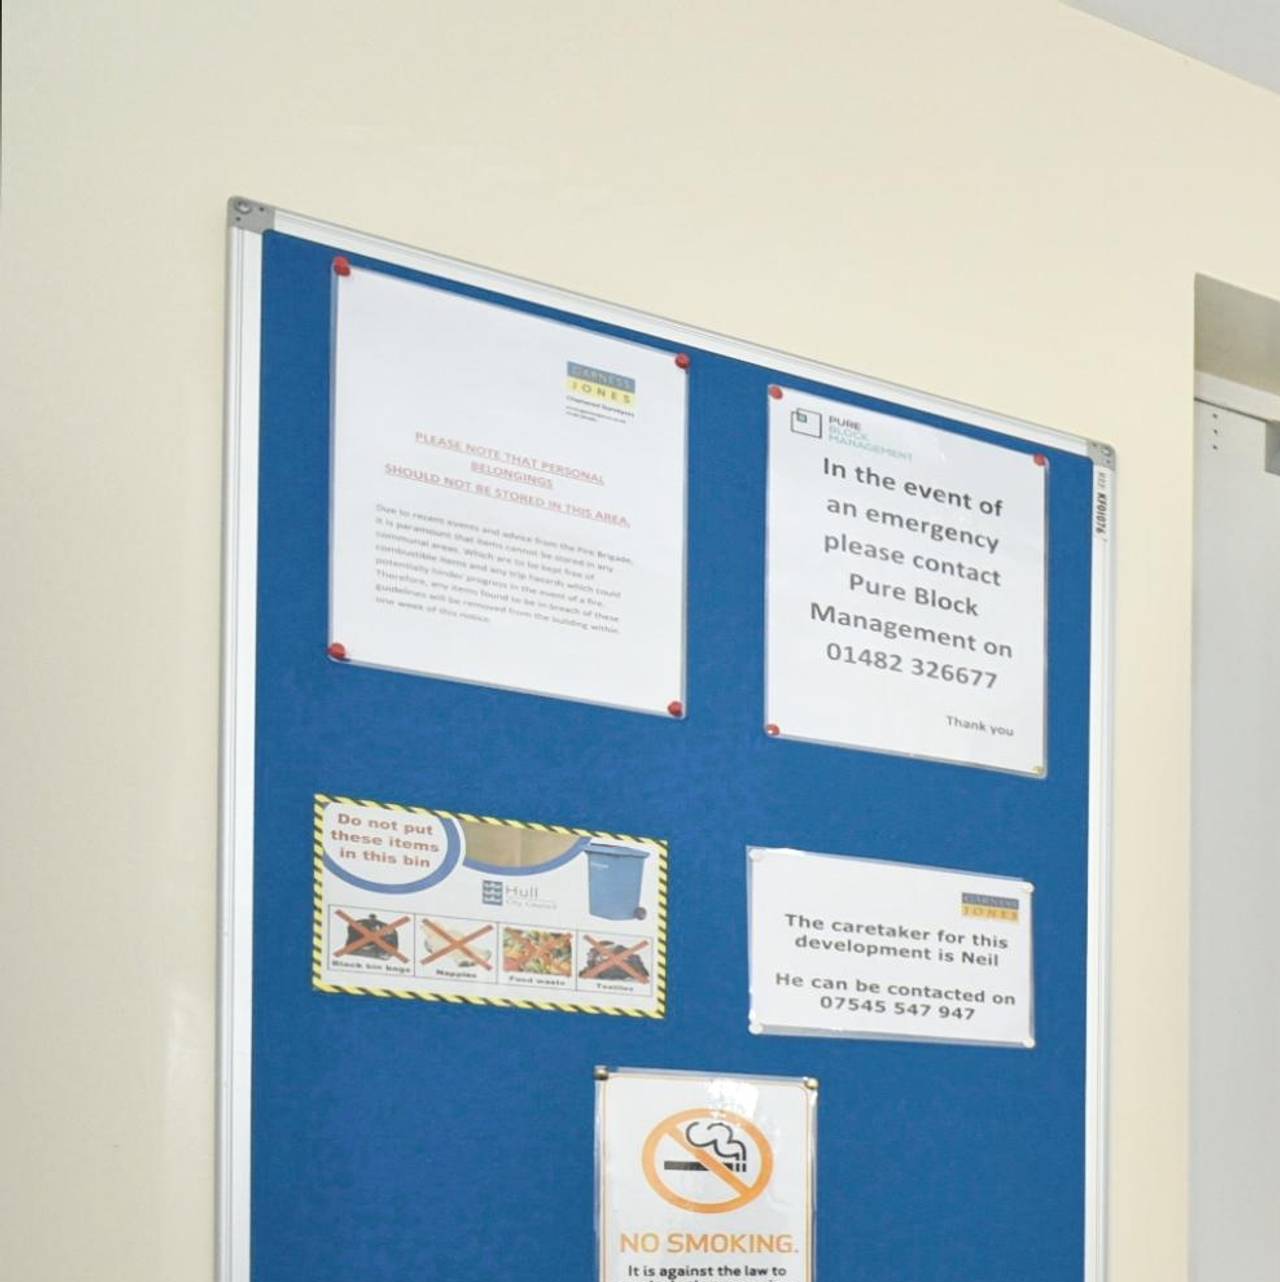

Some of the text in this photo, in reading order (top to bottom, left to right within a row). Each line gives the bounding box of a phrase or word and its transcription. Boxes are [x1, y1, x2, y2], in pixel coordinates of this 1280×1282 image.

[571, 381, 631, 404] JONES
[829, 415, 861, 431] PURE
[415, 432, 605, 485] PLEASE NOTE THAT PERSONAL
[470, 461, 553, 488] BELONGINGS
[824, 457, 1004, 517] In the event of
[384, 463, 440, 485] SHOULD
[444, 477, 472, 492] NOT
[476, 484, 490, 496] BE
[495, 488, 545, 508] STORED
[549, 500, 562, 512] IN
[565, 504, 593, 519] THIS
[827, 498, 999, 554] an emergency
[824, 533, 1001, 586] please contact
[850, 573, 979, 616] Pure Block
[811, 602, 1013, 658] Management on
[826, 642, 997, 689] 01482 326677
[947, 715, 1015, 736] Thank you
[338, 813, 433, 836] Do not put
[331, 830, 440, 852] these items
[340, 847, 431, 868] in this bin
[505, 885, 539, 898] Hull
[785, 913, 1009, 949] The caretaker for this
[795, 935, 999, 967] development is Neil
[775, 973, 1016, 1005] He can be contacted on
[820, 995, 976, 1021] 07545 547 947
[620, 1233, 799, 1253] NO SMOKING.
[628, 1265, 787, 1280] It is against the law to
